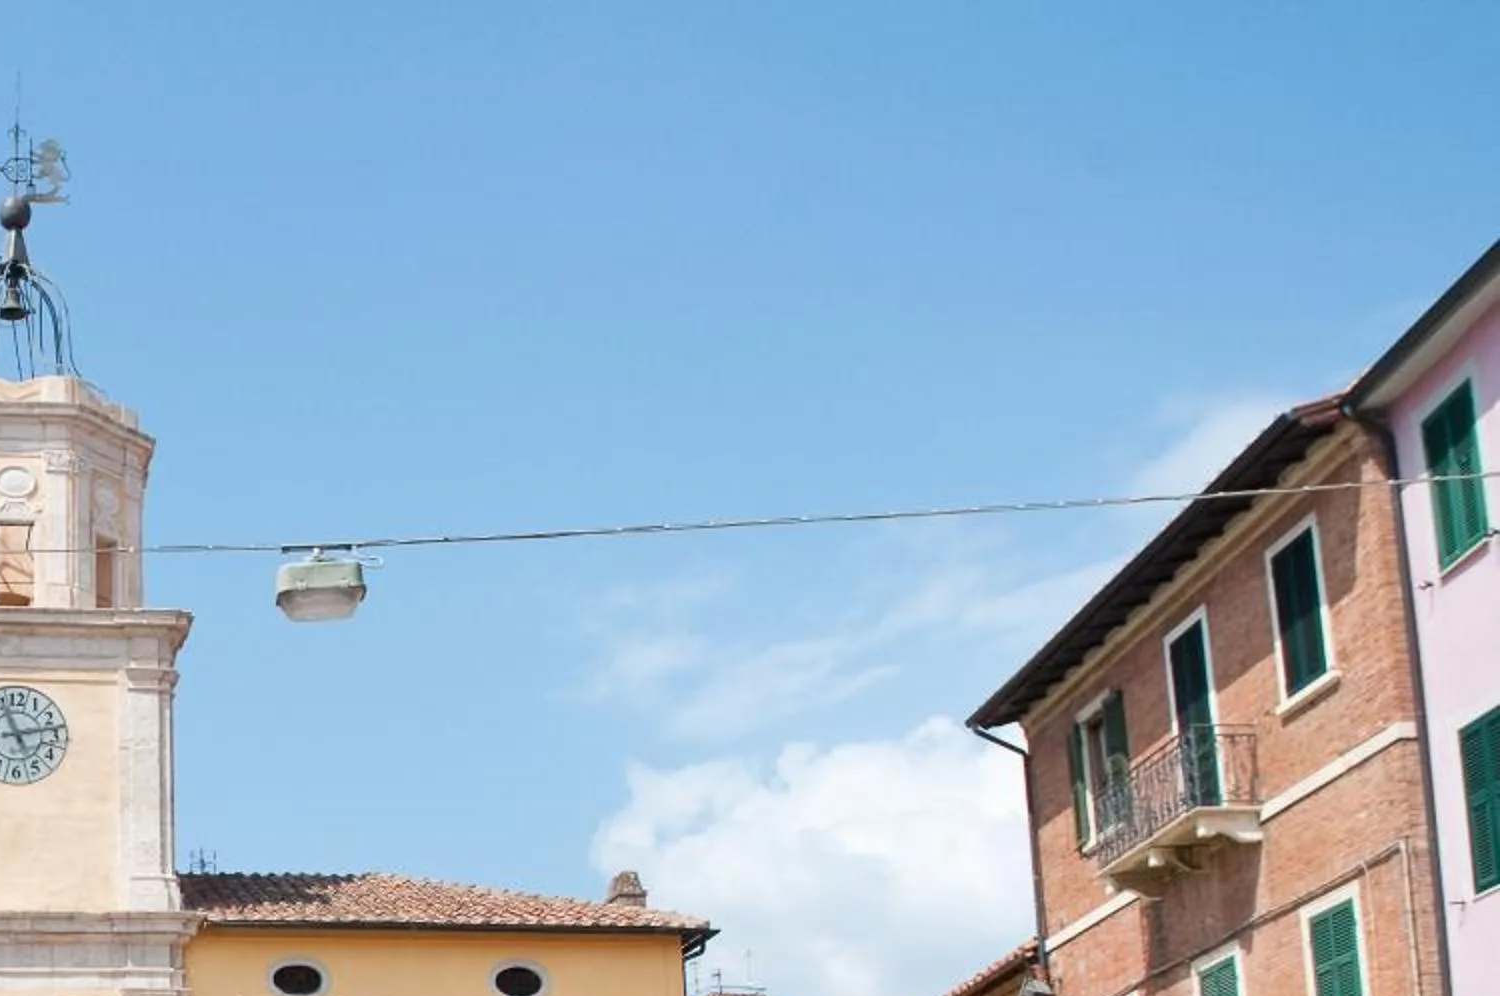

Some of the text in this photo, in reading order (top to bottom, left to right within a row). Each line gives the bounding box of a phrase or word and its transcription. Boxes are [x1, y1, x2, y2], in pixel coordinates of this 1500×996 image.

[10, 692, 25, 707] 12
[33, 697, 38, 711] 1
[44, 711, 53, 725] 2
[44, 747, 54, 760] 4
[11, 765, 21, 779] 6
[30, 760, 40, 775] 5
